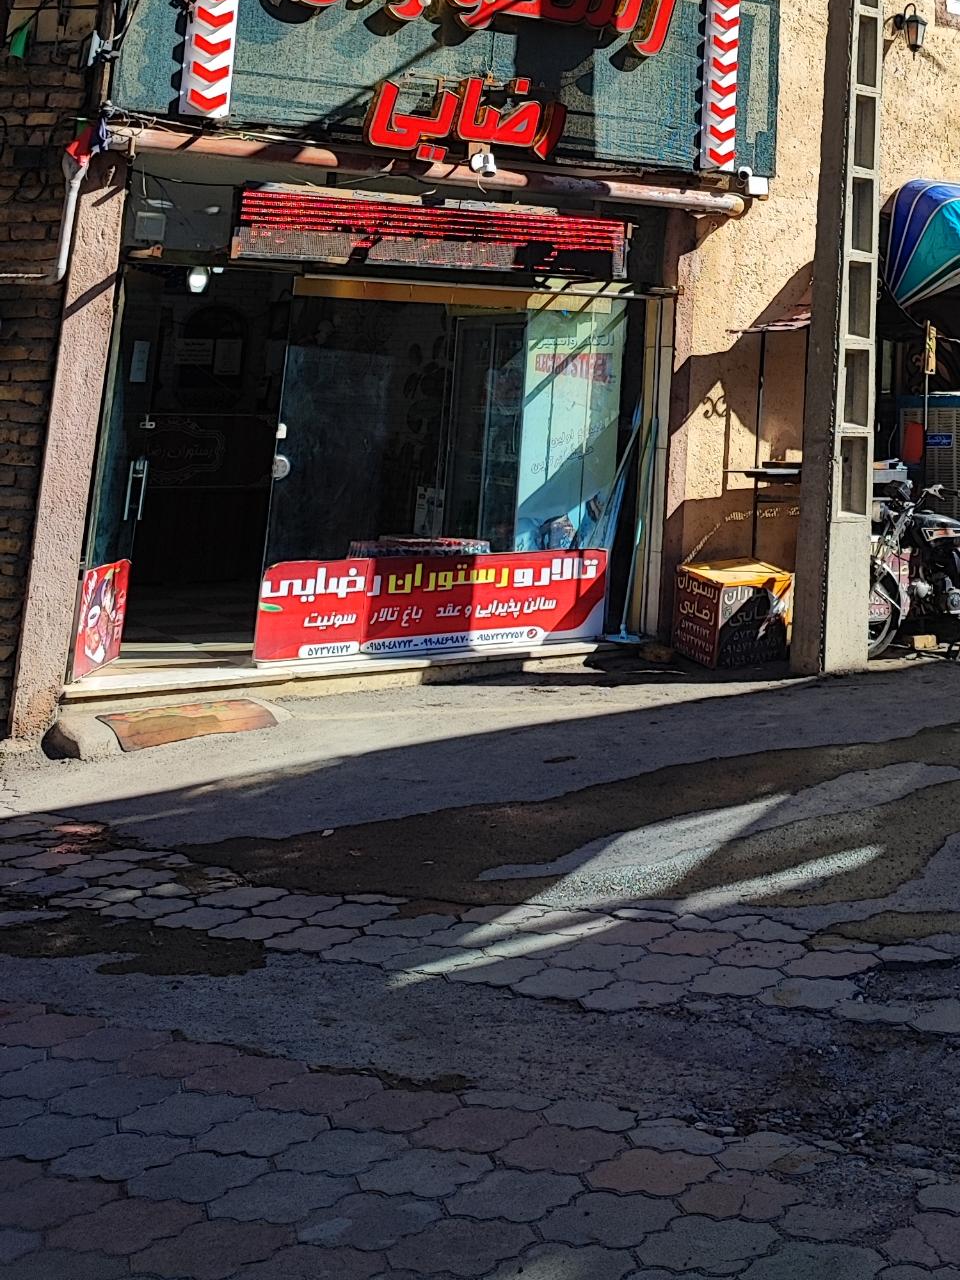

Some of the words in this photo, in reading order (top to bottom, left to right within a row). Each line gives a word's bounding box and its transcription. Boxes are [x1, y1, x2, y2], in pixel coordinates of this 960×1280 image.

[363, 75, 567, 162] رضایی
[388, 563, 509, 594] رستوران
[534, 558, 598, 586] تالار
[261, 567, 381, 602] رضایی
[370, 606, 400, 624] تالار
[436, 603, 461, 617] عقد
[475, 597, 521, 618] پذیرایی
[523, 596, 557, 613] سالن
